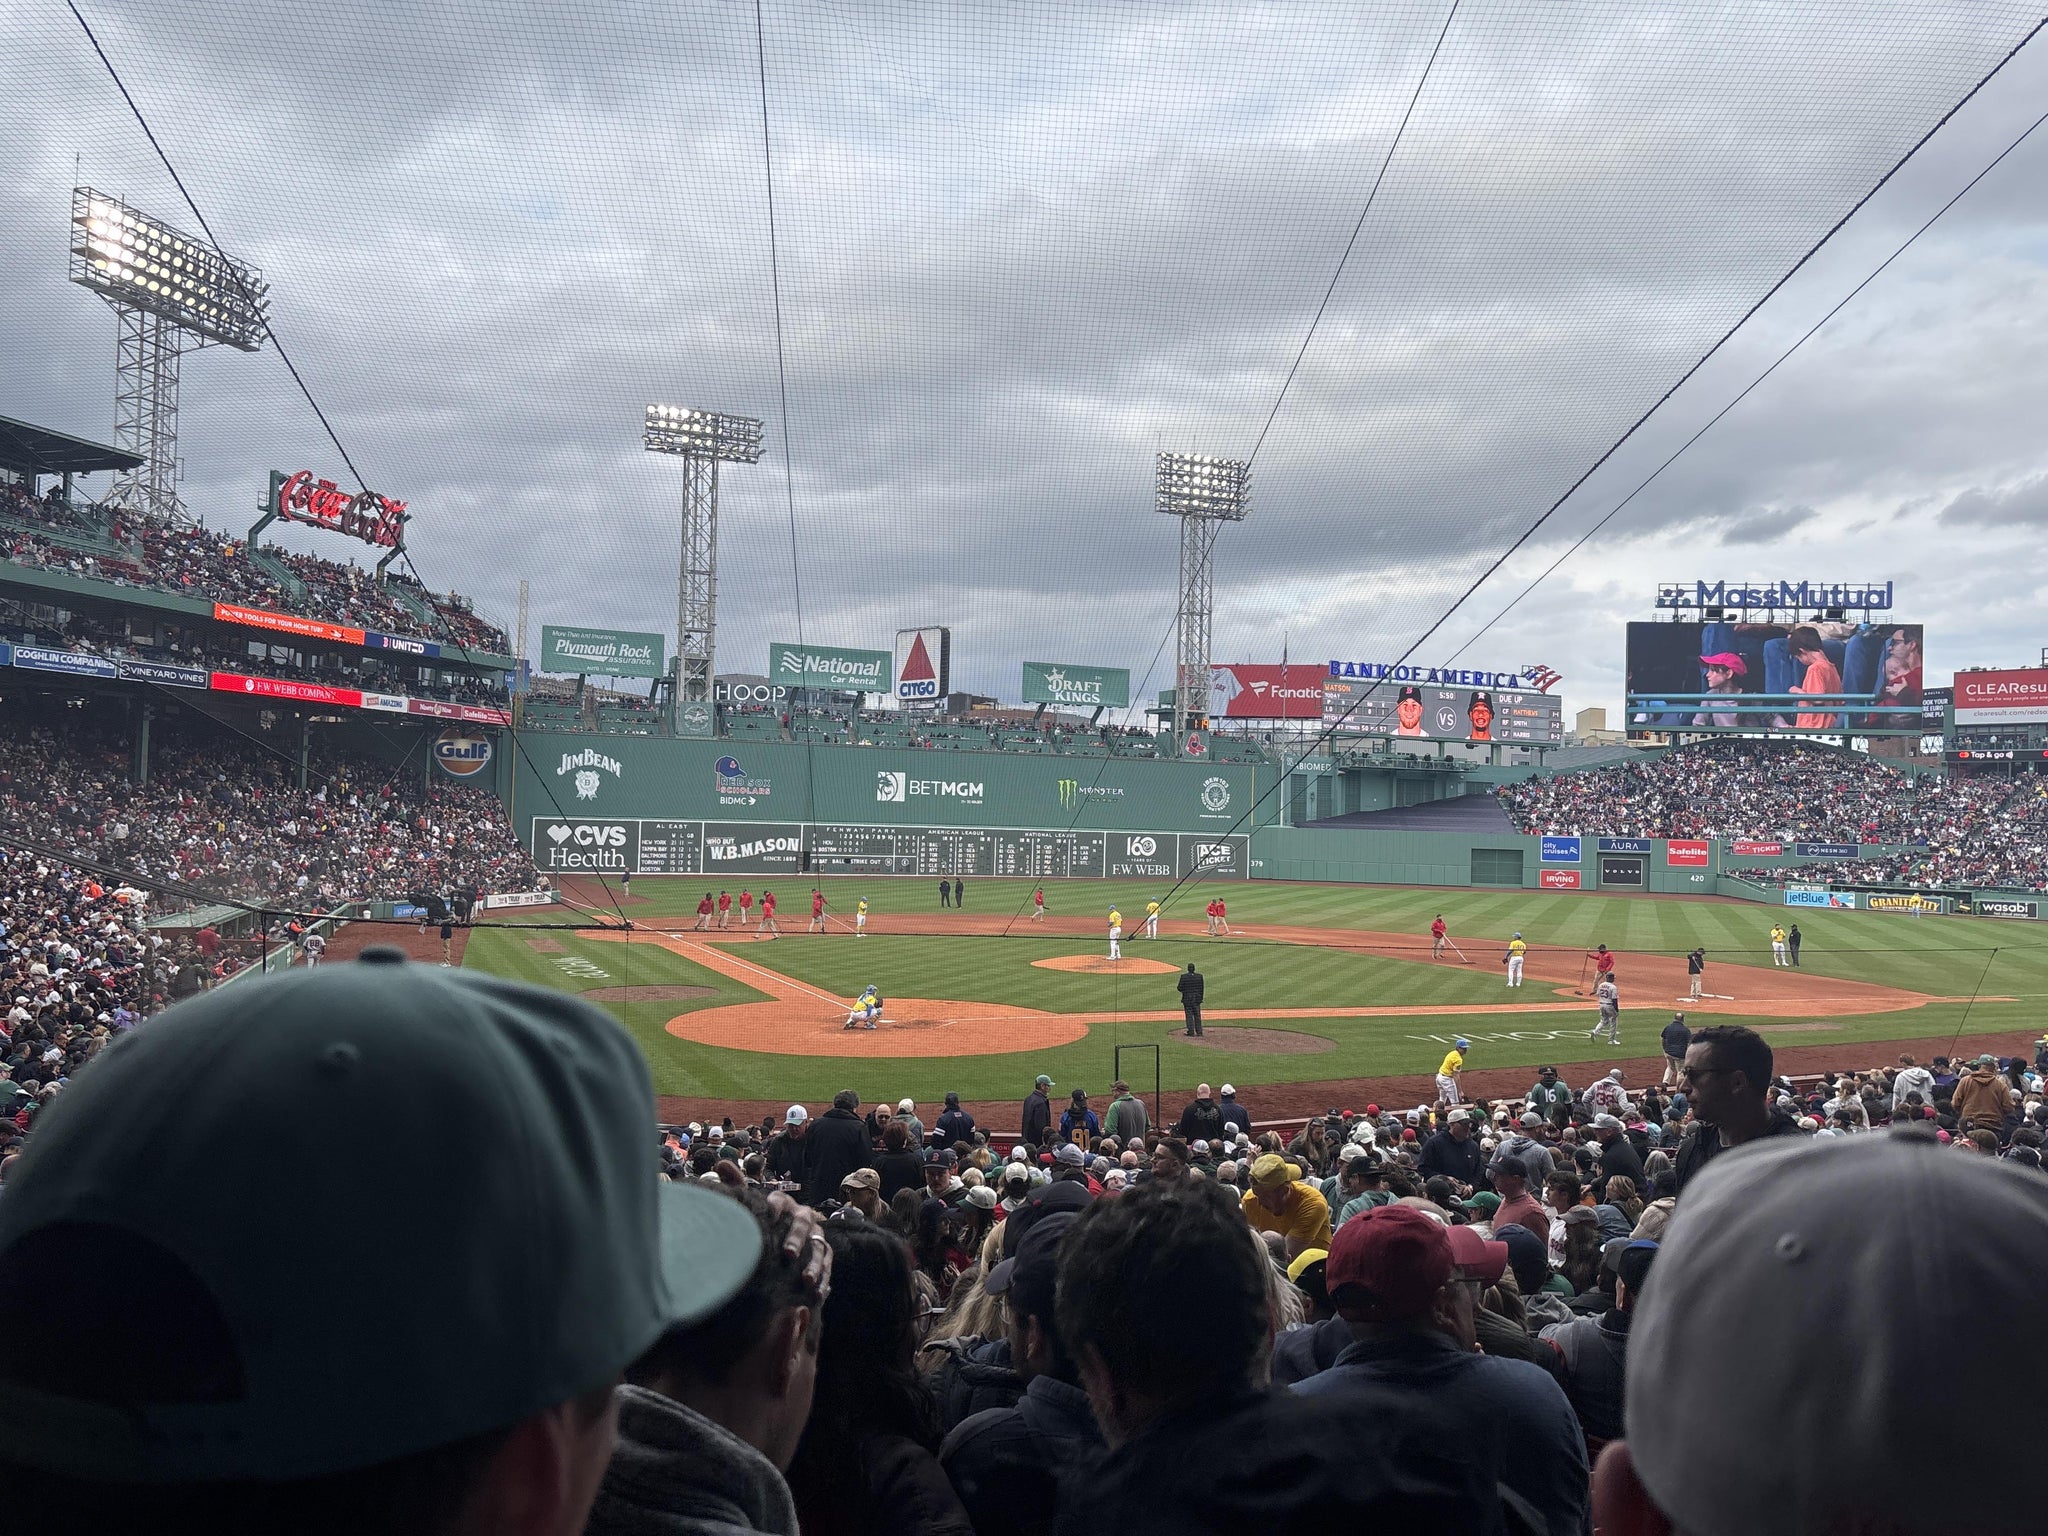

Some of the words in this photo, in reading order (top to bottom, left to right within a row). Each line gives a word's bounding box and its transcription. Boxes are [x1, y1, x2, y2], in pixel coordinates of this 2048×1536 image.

[1697, 580, 1892, 609] MassMutual
[244, 612, 263, 622] TOOLS
[265, 615, 276, 624] FOR
[278, 617, 292, 628] YOUR
[294, 620, 309, 630] HOME
[310, 623, 324, 633] TURF
[392, 640, 424, 654] UNITED
[556, 640, 617, 655] Plymouth
[619, 644, 652, 658] Rock
[16, 649, 59, 663] COGHLIN
[61, 655, 115, 669] COMPANIES
[804, 655, 879, 676] National
[131, 667, 176, 680] VINEYARD
[178, 673, 204, 683] VINES
[1329, 660, 1394, 678] BANK
[1395, 666, 1422, 681] OF
[1428, 668, 1518, 688] AMERICA
[831, 676, 847, 684] Car
[849, 677, 876, 686] Rental
[1048, 679, 1102, 692] DRAFT
[274, 684, 296, 695] WEBB
[298, 688, 336, 700] COMPANY
[900, 682, 935, 697] CITGO
[1325, 684, 1351, 692] WATSON
[1966, 683, 2046, 695] CLEAResu
[1054, 690, 1100, 703] KINGS
[464, 710, 488, 719] Safelite
[1440, 713, 1454, 726] VS
[436, 742, 488, 759] Gulf
[1971, 752, 1985, 760] Tap
[720, 778, 744, 786] RED
[747, 779, 771, 787] SOX
[909, 780, 983, 796] BETMGM
[720, 786, 771, 795] SCHOLARS
[720, 797, 747, 805] BIDMC
[574, 825, 626, 846] CVS
[1127, 837, 1156, 856] 160
[1200, 844, 1231, 856] ACE
[1544, 842, 1556, 850] city
[1669, 848, 1707, 856] Safelite
[1753, 845, 1781, 854] TICKET
[549, 848, 625, 867] Health
[1112, 865, 1132, 875] F.W.
[1136, 865, 1170, 876] WEBB
[1546, 875, 1574, 883] IRVING
[1788, 893, 1824, 903] jetBlue
[1983, 902, 2028, 913] wasabi
[1600, 989, 1609, 998] 23
[1544, 1089, 1556, 1102] 16
[1072, 1128, 1090, 1152] 91
